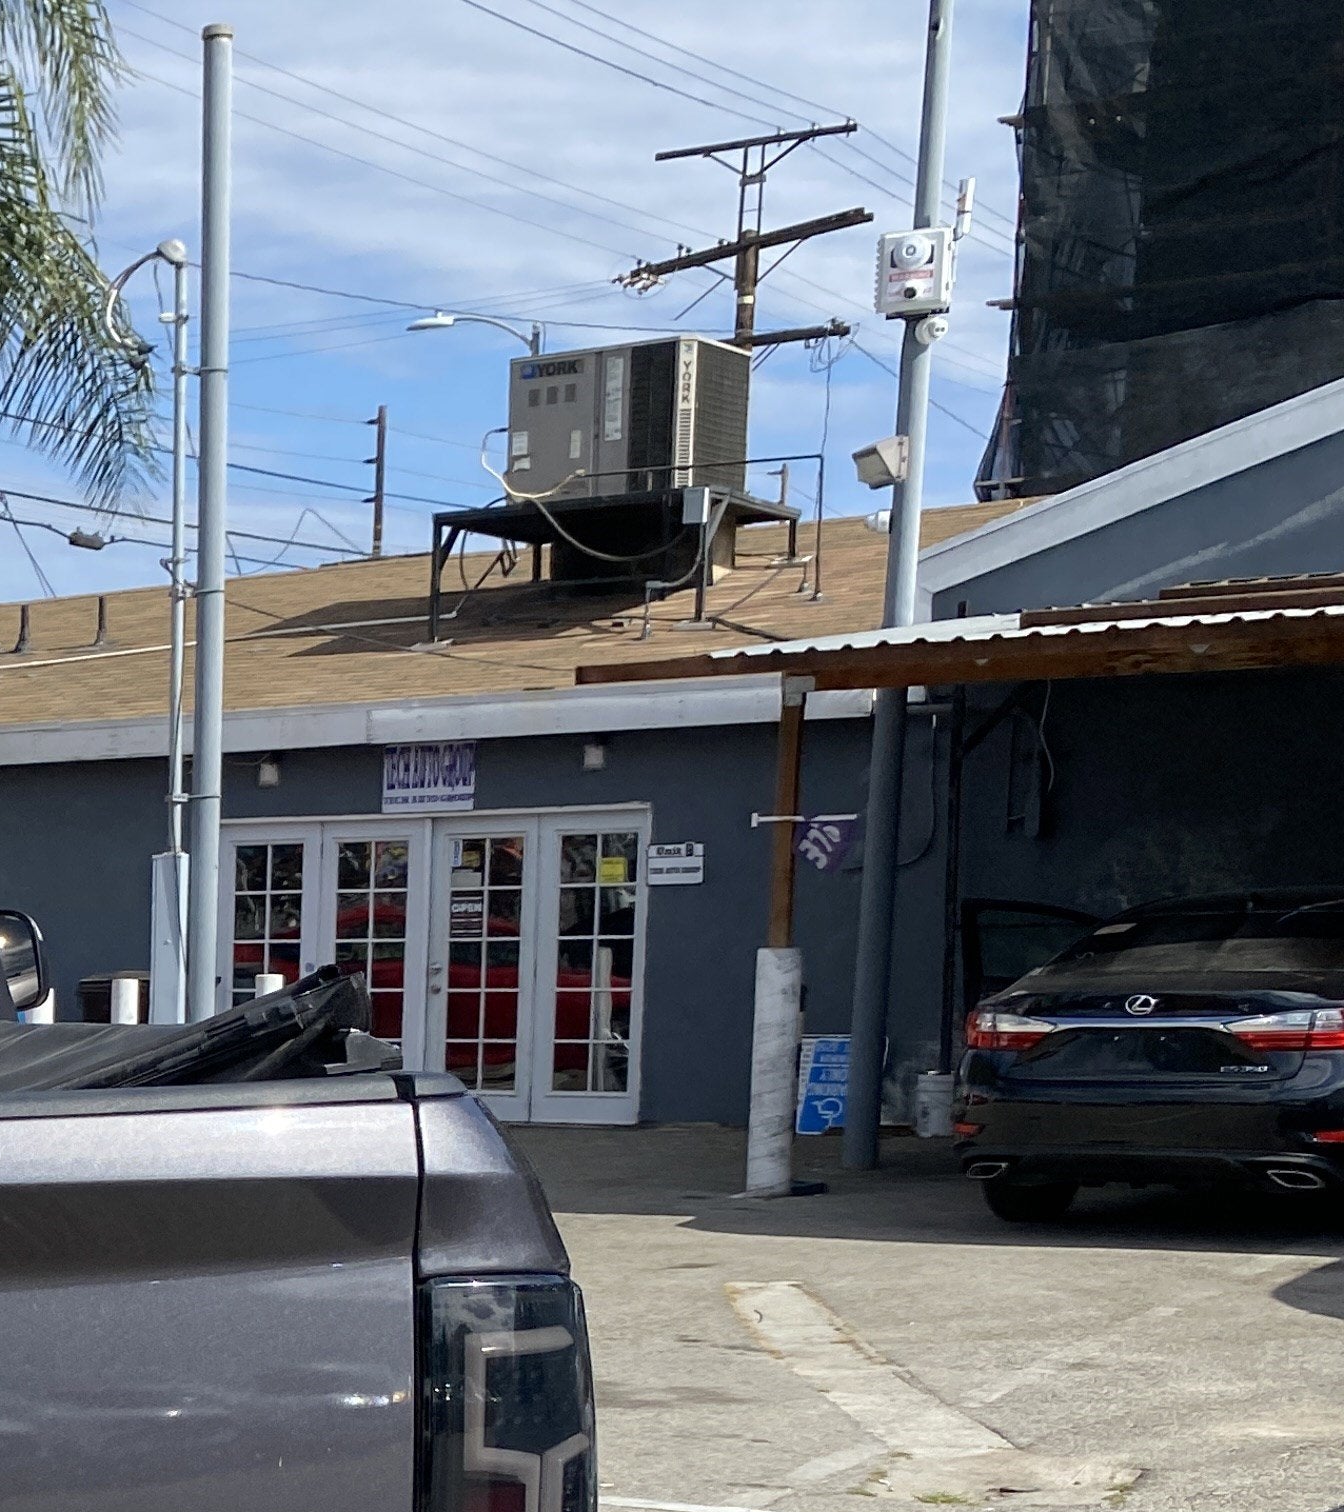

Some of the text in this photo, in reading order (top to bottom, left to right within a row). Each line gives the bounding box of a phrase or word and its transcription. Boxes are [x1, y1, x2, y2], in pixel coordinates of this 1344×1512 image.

[537, 360, 578, 377] YORK
[681, 361, 692, 403] YORK
[451, 902, 483, 913] OPEN
